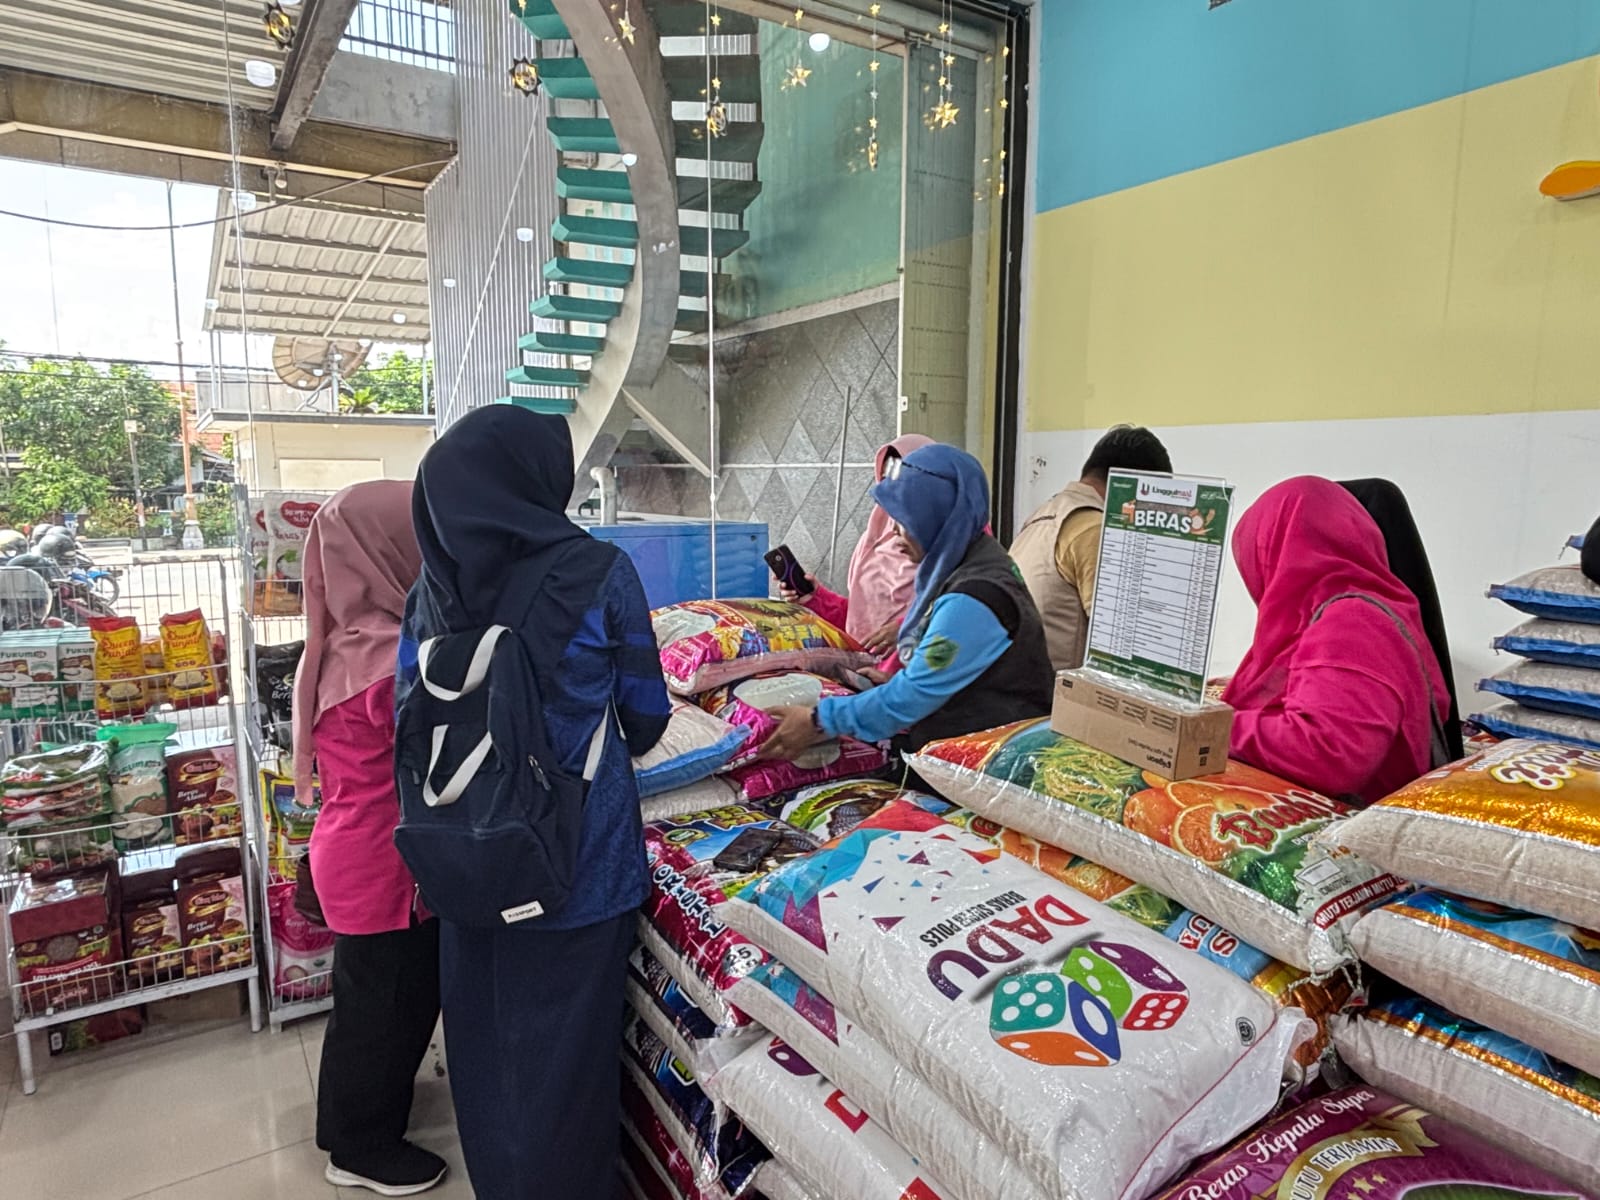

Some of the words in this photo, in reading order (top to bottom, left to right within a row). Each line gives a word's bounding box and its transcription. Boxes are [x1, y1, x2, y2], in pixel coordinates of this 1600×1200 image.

[1134, 509, 1192, 534] BERAS
[1146, 754, 1172, 769] Pigeon
[986, 890, 1028, 912] BERAS
[1339, 886, 1374, 911] TERJAMIN
[919, 918, 962, 948] POLES
[726, 946, 752, 967] 25
[926, 893, 1091, 1001] DADU
[1178, 1163, 1250, 1200] Beras
[1246, 1111, 1325, 1164] Kepala
[1313, 1135, 1399, 1172] TERJAMIN
